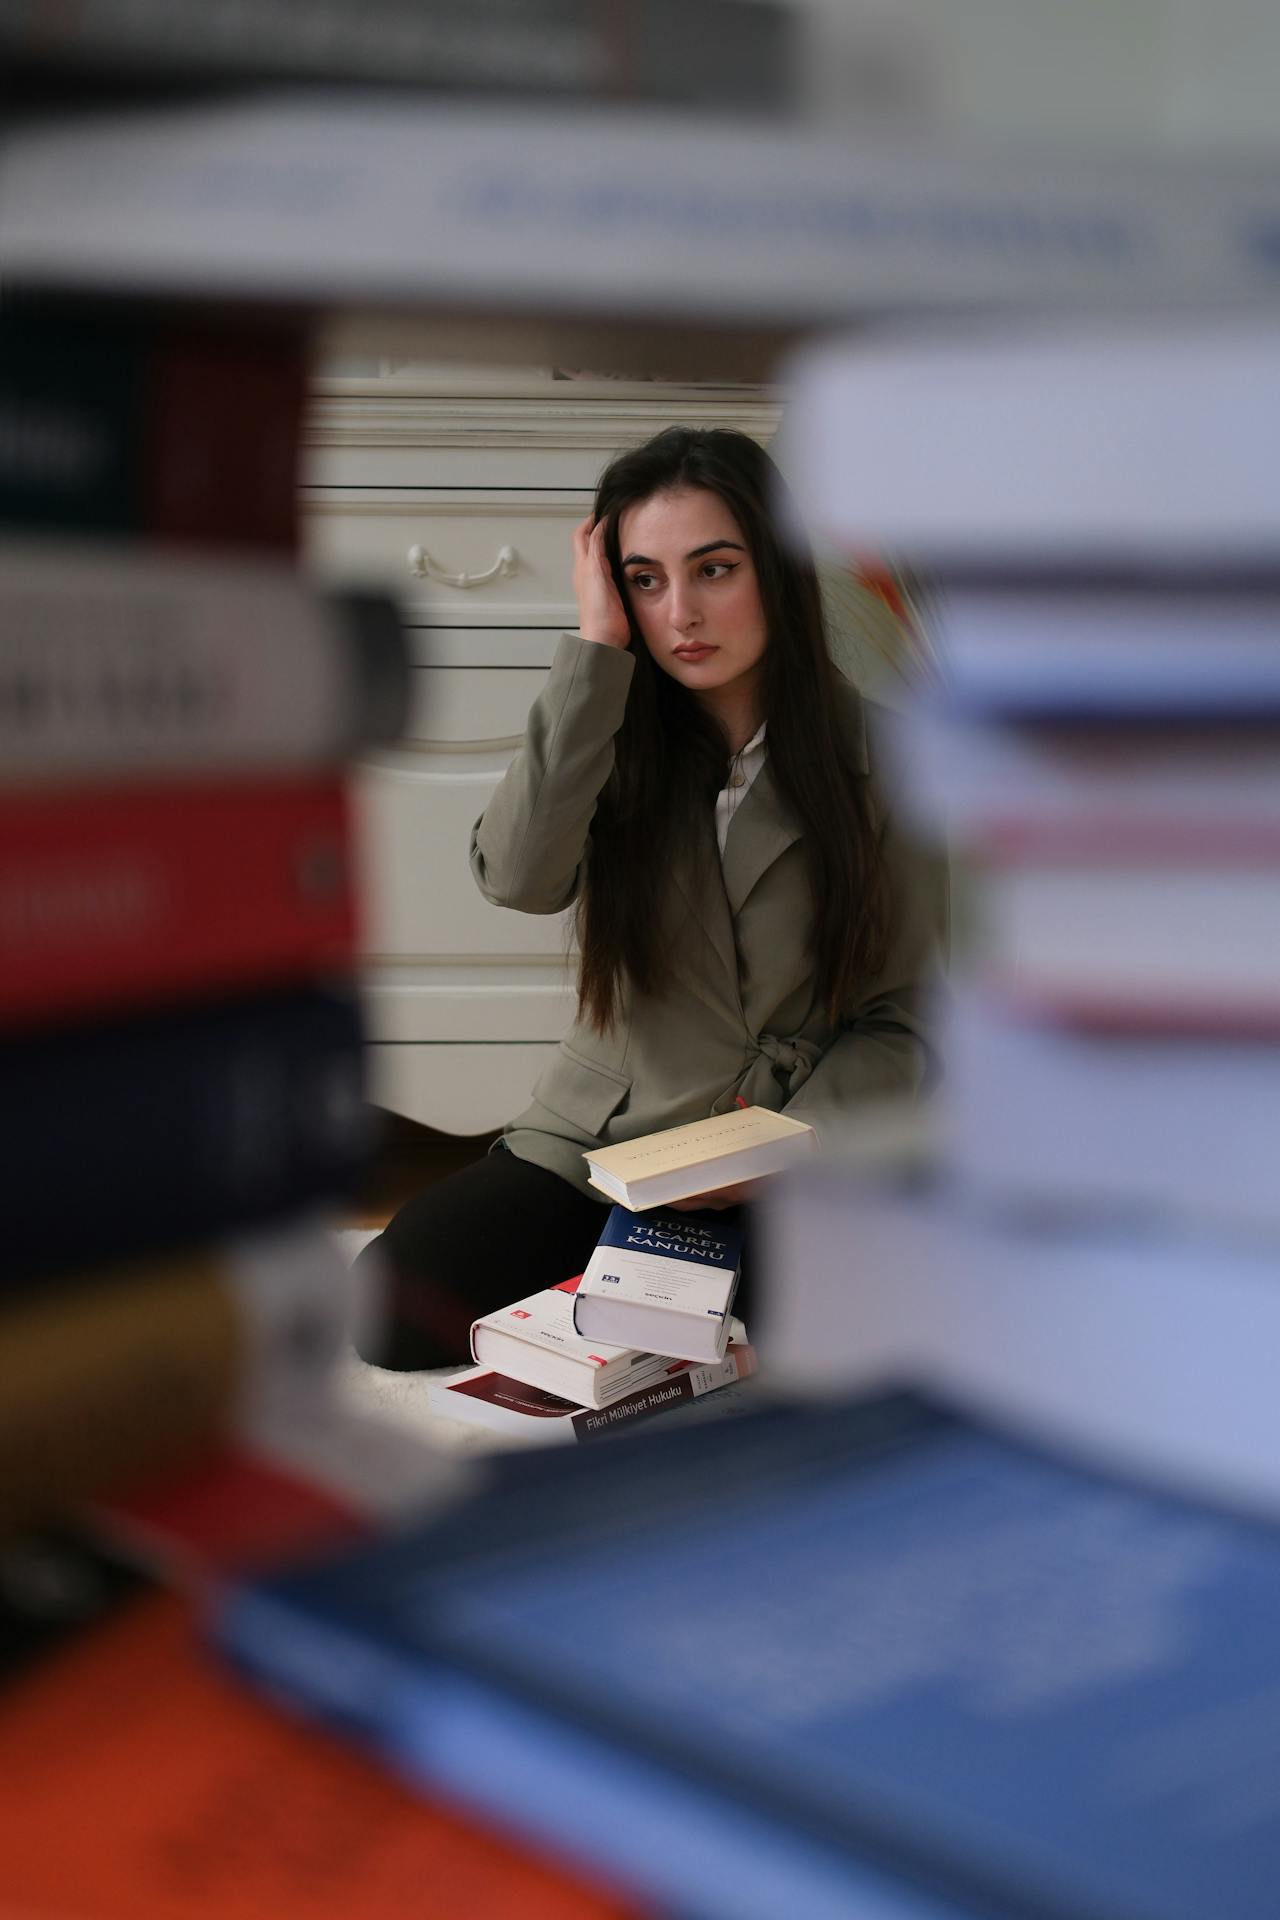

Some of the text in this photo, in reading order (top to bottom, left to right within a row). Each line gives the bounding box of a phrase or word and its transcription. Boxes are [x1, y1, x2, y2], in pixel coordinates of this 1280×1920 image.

[626, 1235, 724, 1260] KANUNU
[632, 1225, 727, 1250] TİCARET
[586, 1385, 682, 1431] Fikri Mülkiyet Hukuku
